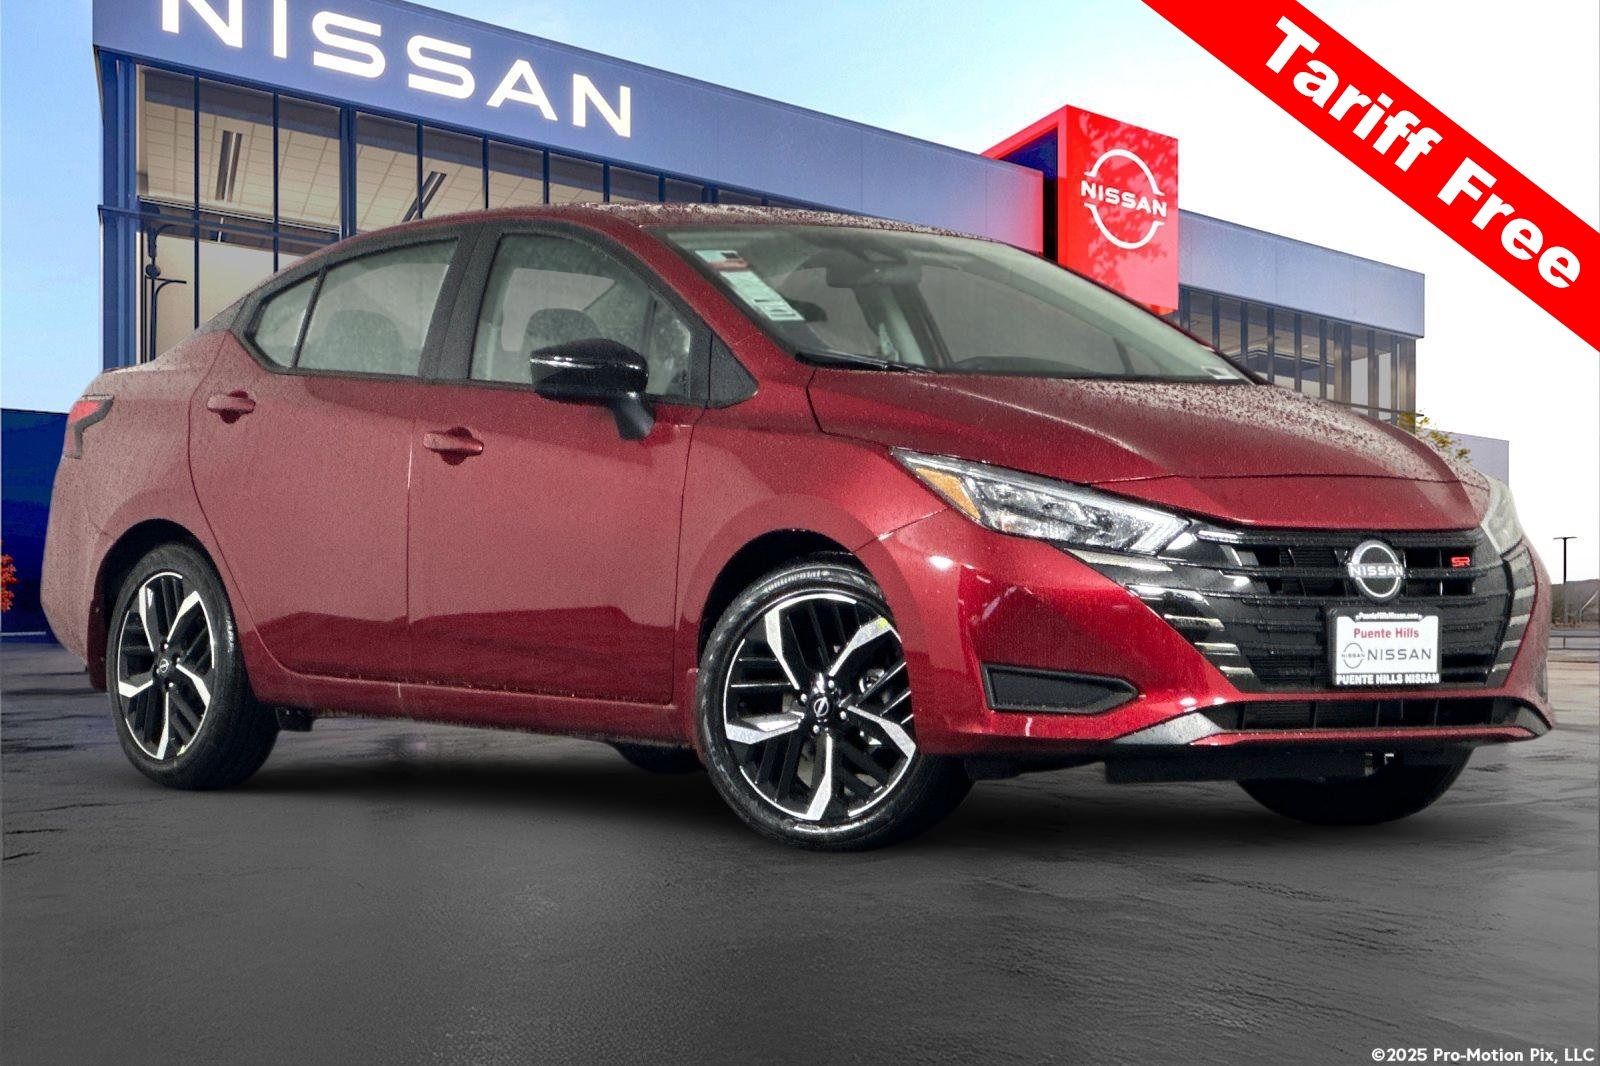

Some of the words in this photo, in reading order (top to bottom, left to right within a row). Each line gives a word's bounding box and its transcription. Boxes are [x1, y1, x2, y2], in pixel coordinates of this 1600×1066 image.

[161, 0, 631, 138] NISSAN
[1080, 180, 1168, 217] NISSAN
[1451, 556, 1471, 568] SR
[1350, 564, 1404, 577] NISSAN
[1353, 628, 1392, 639] Puente
[1395, 627, 1420, 638] Hills
[1367, 648, 1431, 661] NISSAN
[1336, 674, 1374, 685] PUENTE
[1375, 674, 1404, 684] HILLS
[1405, 673, 1440, 684] NISSAN
